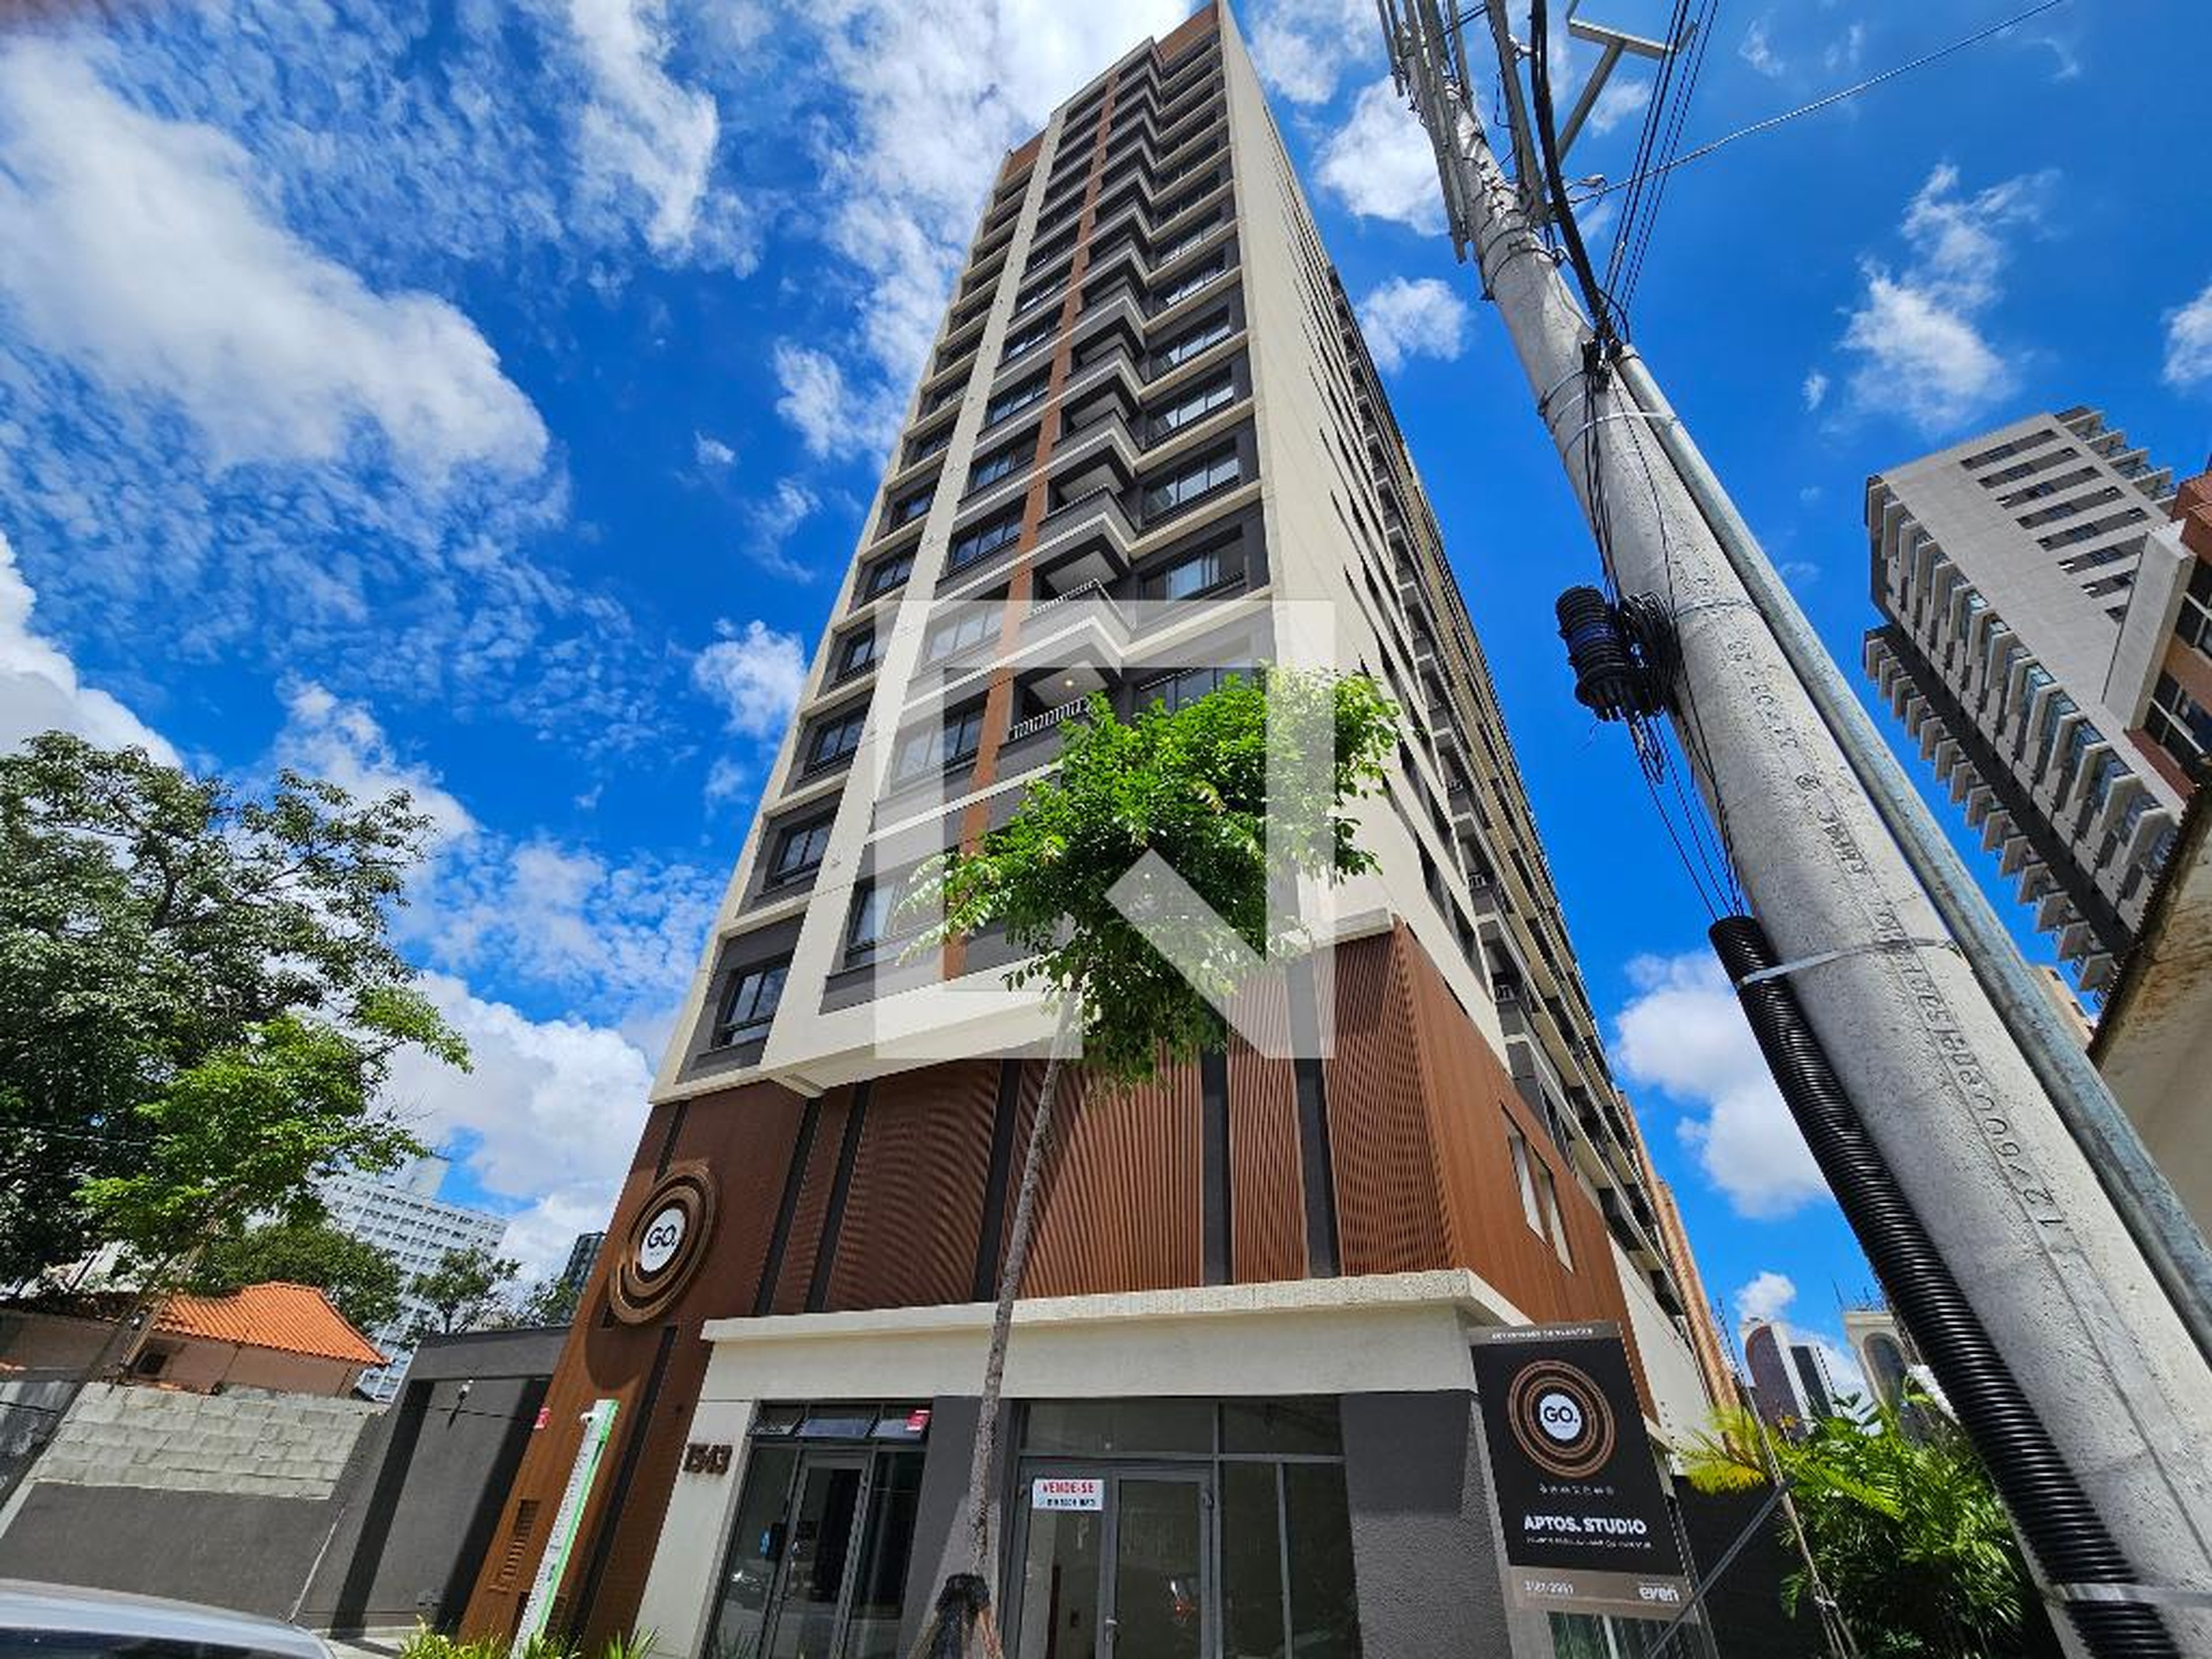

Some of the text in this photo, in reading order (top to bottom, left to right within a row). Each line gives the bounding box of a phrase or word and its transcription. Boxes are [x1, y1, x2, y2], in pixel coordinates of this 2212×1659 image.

[1043, 1482, 1094, 1493] VENDE-SE
[1583, 1517, 1647, 1535] STUDIO
[1639, 1587, 1680, 1602] even
